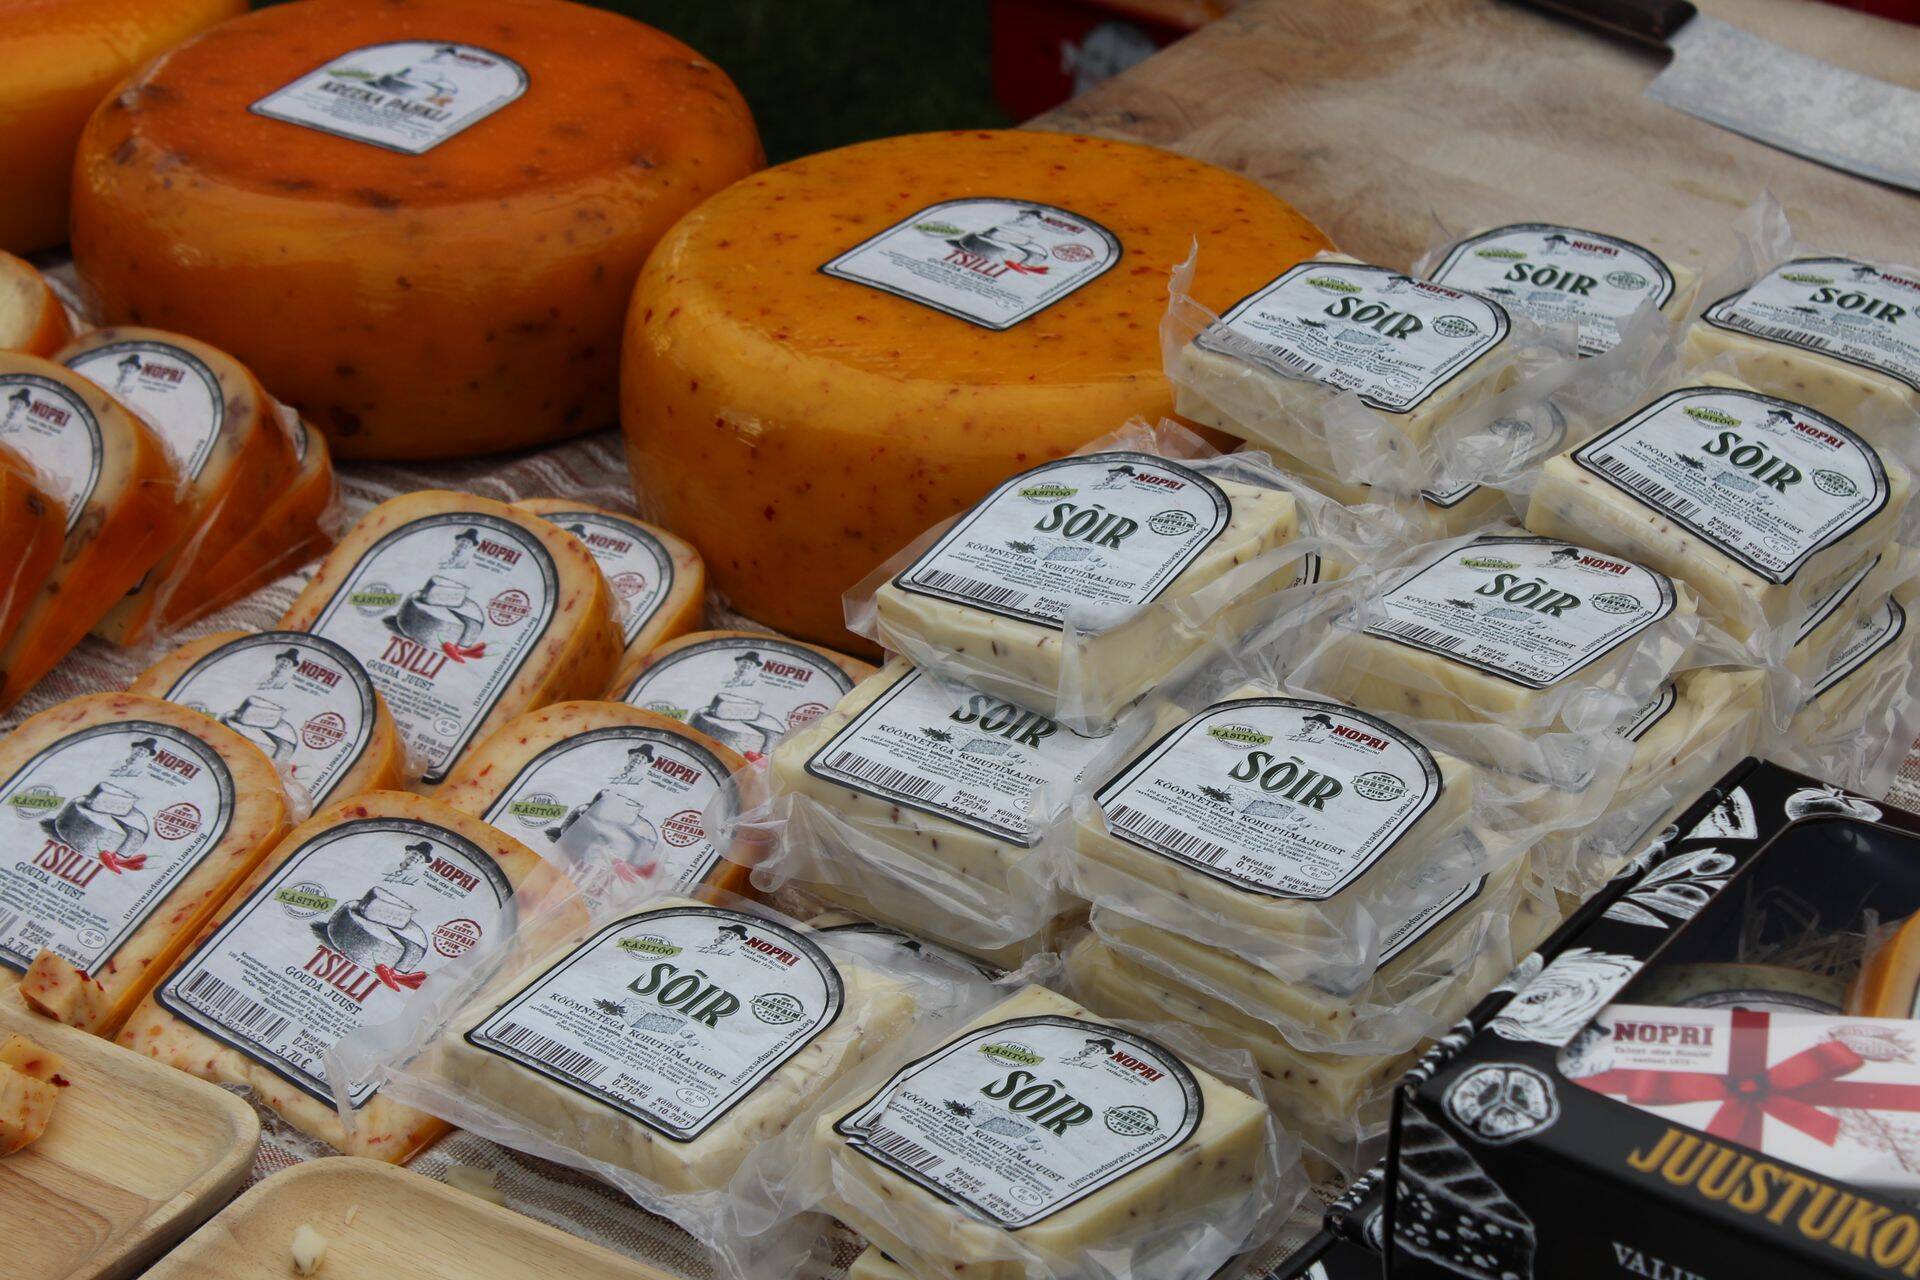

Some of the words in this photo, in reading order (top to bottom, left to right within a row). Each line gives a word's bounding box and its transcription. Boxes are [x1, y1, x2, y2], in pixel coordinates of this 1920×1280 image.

[1043, 216, 1087, 234] NOPRI
[1571, 239, 1620, 257] NOPRI
[942, 249, 1011, 279] TSILLI
[1414, 280, 1465, 301] NOPRI
[140, 363, 186, 384] NOPRI
[29, 400, 72, 428] NOPRI
[1794, 421, 1847, 450] NOPRI
[1134, 472, 1187, 491] NOPRI
[1022, 489, 1072, 498] KÄSITÖÖ
[476, 540, 522, 565] NOPRI
[585, 533, 633, 553] NOPRI
[1041, 562, 1136, 588] KOHUPIIMAJUUST
[1577, 555, 1632, 576] NOPRI
[380, 635, 450, 682] TSILLI
[296, 661, 342, 687] NOPRI
[366, 659, 400, 679] GOUDA
[401, 673, 436, 692] JUUST
[762, 660, 814, 683] NOPRI
[879, 723, 954, 756] KÖÖMNETEGA
[1212, 729, 1266, 744] KÄSITÖÖ
[1231, 725, 1253, 733] 100%
[1332, 724, 1391, 751] NOPRI
[152, 750, 200, 778] NOPRI
[651, 757, 702, 785] NOPRI
[1355, 777, 1404, 795] PUHTAIM
[1372, 775, 1396, 785] EESTI
[1367, 788, 1385, 796] PIIM
[514, 804, 561, 817] KÄSITÖÖ
[1240, 814, 1346, 856] KOHUPIIMAJUUST
[31, 838, 106, 889] TSILLI
[14, 861, 51, 884] GOUDA
[50, 880, 86, 901] JUUST
[428, 857, 480, 892] NOPRI
[279, 891, 330, 911] KÄSITÖÖ
[299, 885, 321, 896] 100%
[454, 924, 474, 936] EESTI
[642, 936, 664, 944] 100%
[3, 936, 28, 957] 3.70
[443, 939, 460, 951] PIIM
[621, 939, 676, 956] KÄSITÖÖ
[744, 937, 802, 966] NOPRI
[303, 944, 383, 1004] TSILLI
[285, 965, 324, 993] GOUDA
[323, 990, 362, 1015] JUUST
[754, 998, 801, 1020] PUHTAIM
[772, 998, 796, 1008] EESTI
[763, 1010, 781, 1019] PIIM
[299, 1029, 330, 1050] Netokaal
[1613, 1022, 1714, 1046] NOPRI
[276, 1044, 303, 1063] 3.70
[629, 1029, 728, 1081] KOHUPIIMAJUUST
[982, 1045, 1038, 1065] KÄSITÖÖ
[1004, 1043, 1028, 1053] 100%
[1109, 1051, 1166, 1082] NOPRI
[973, 1129, 1066, 1182] KOHUPIIMAJUUST
[1626, 1128, 1920, 1278] JUUSTUKO
